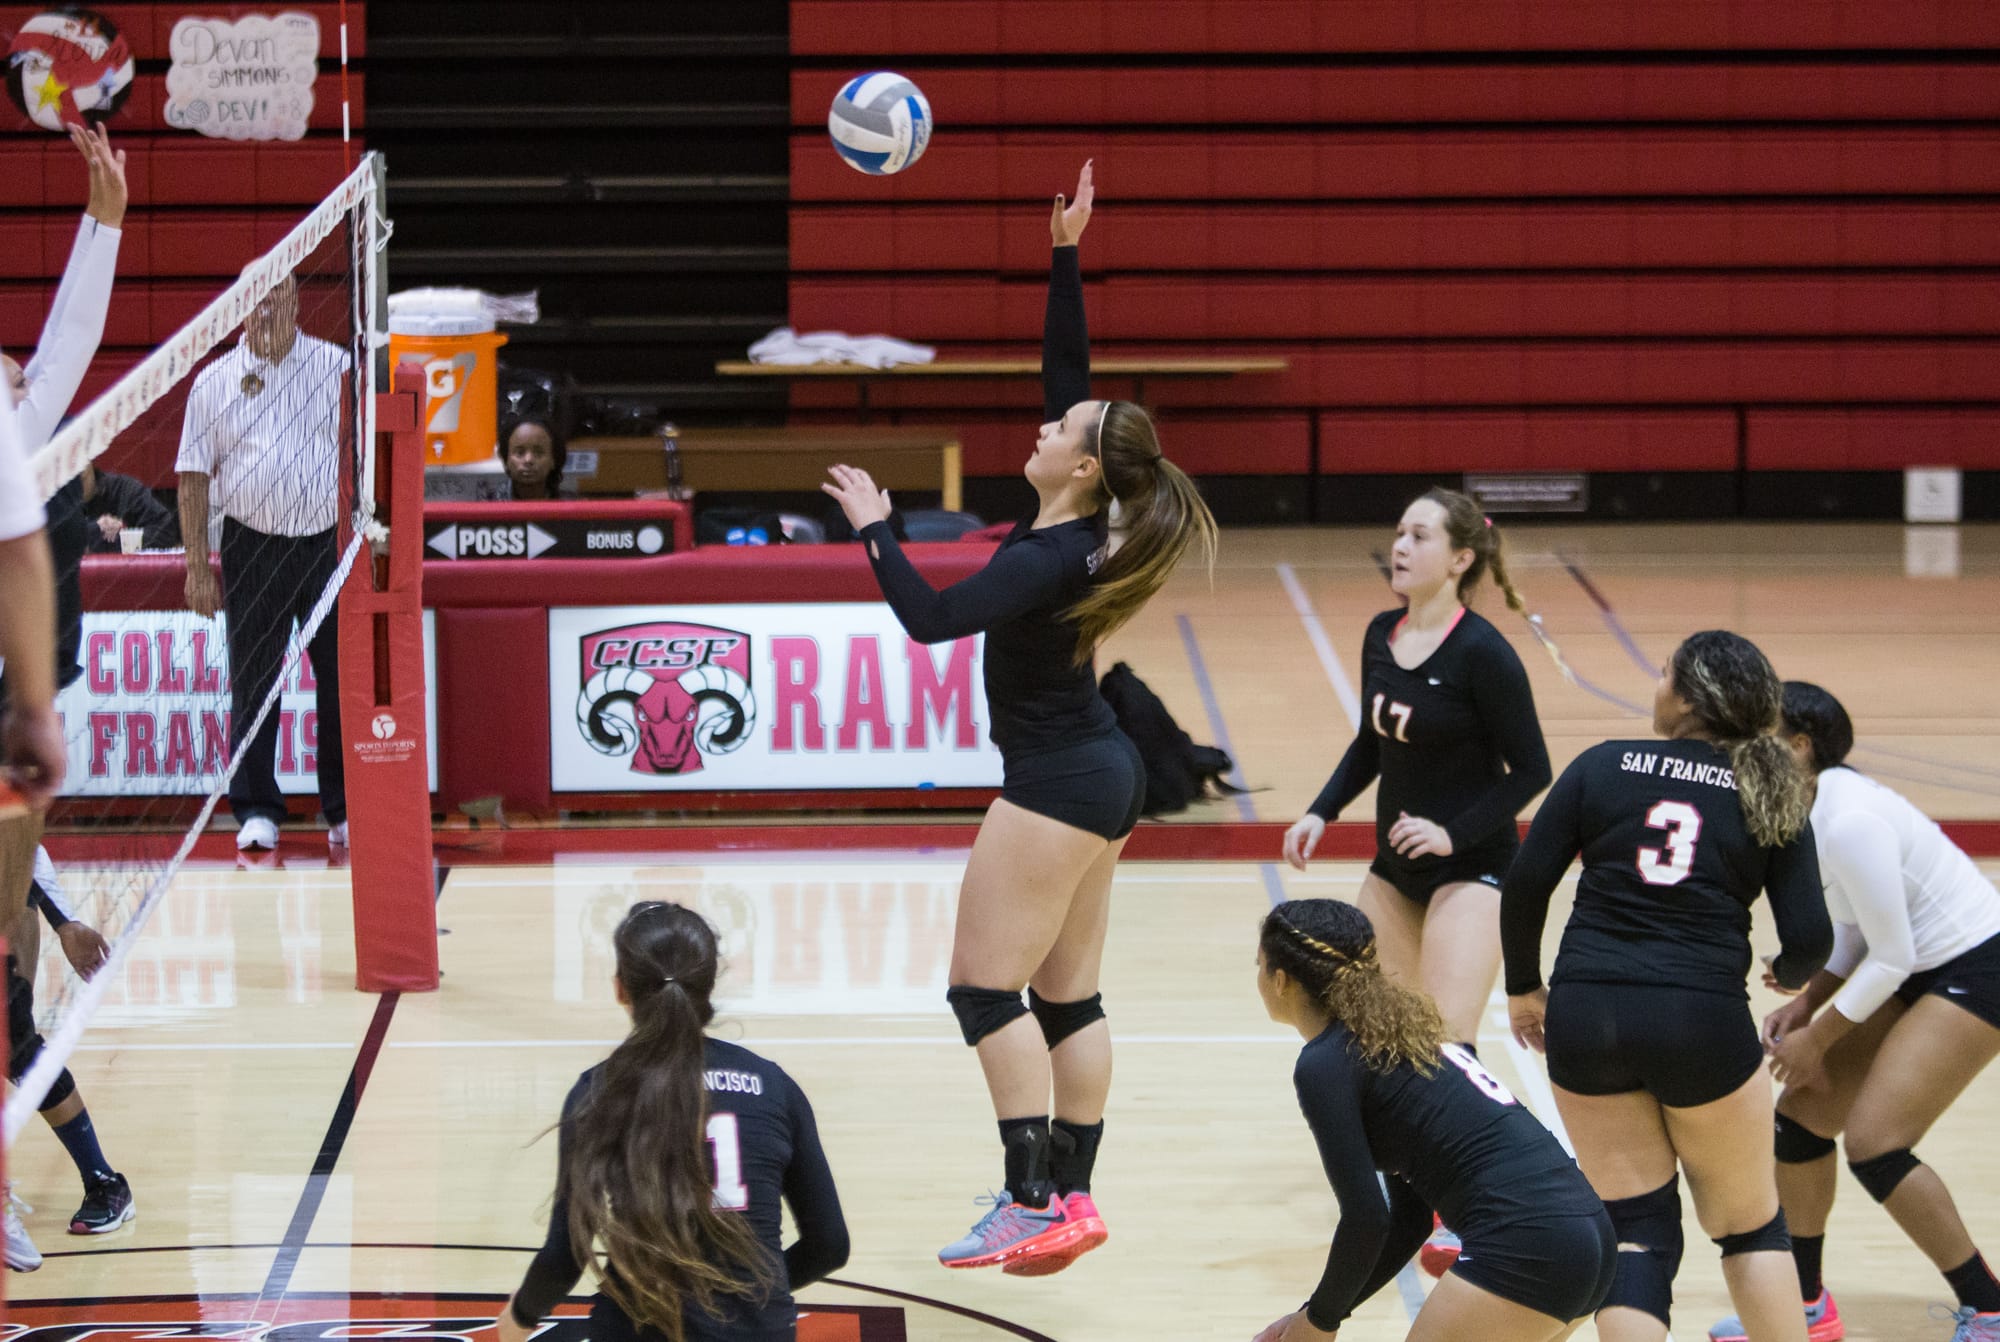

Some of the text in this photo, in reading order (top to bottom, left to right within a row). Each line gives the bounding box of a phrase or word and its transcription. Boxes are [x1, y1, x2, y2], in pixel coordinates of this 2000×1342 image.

[208, 67, 290, 89] SIMMONS
[426, 360, 455, 398] G
[459, 529, 634, 555] POSS BONUS
[87, 631, 317, 696] COLL
[593, 638, 739, 668] CCSF
[769, 634, 981, 754] RAM
[1372, 692, 1413, 744] 17
[1620, 752, 1658, 775] SAN
[1636, 800, 1703, 886] 3
[1439, 1042, 1517, 1106] 8
